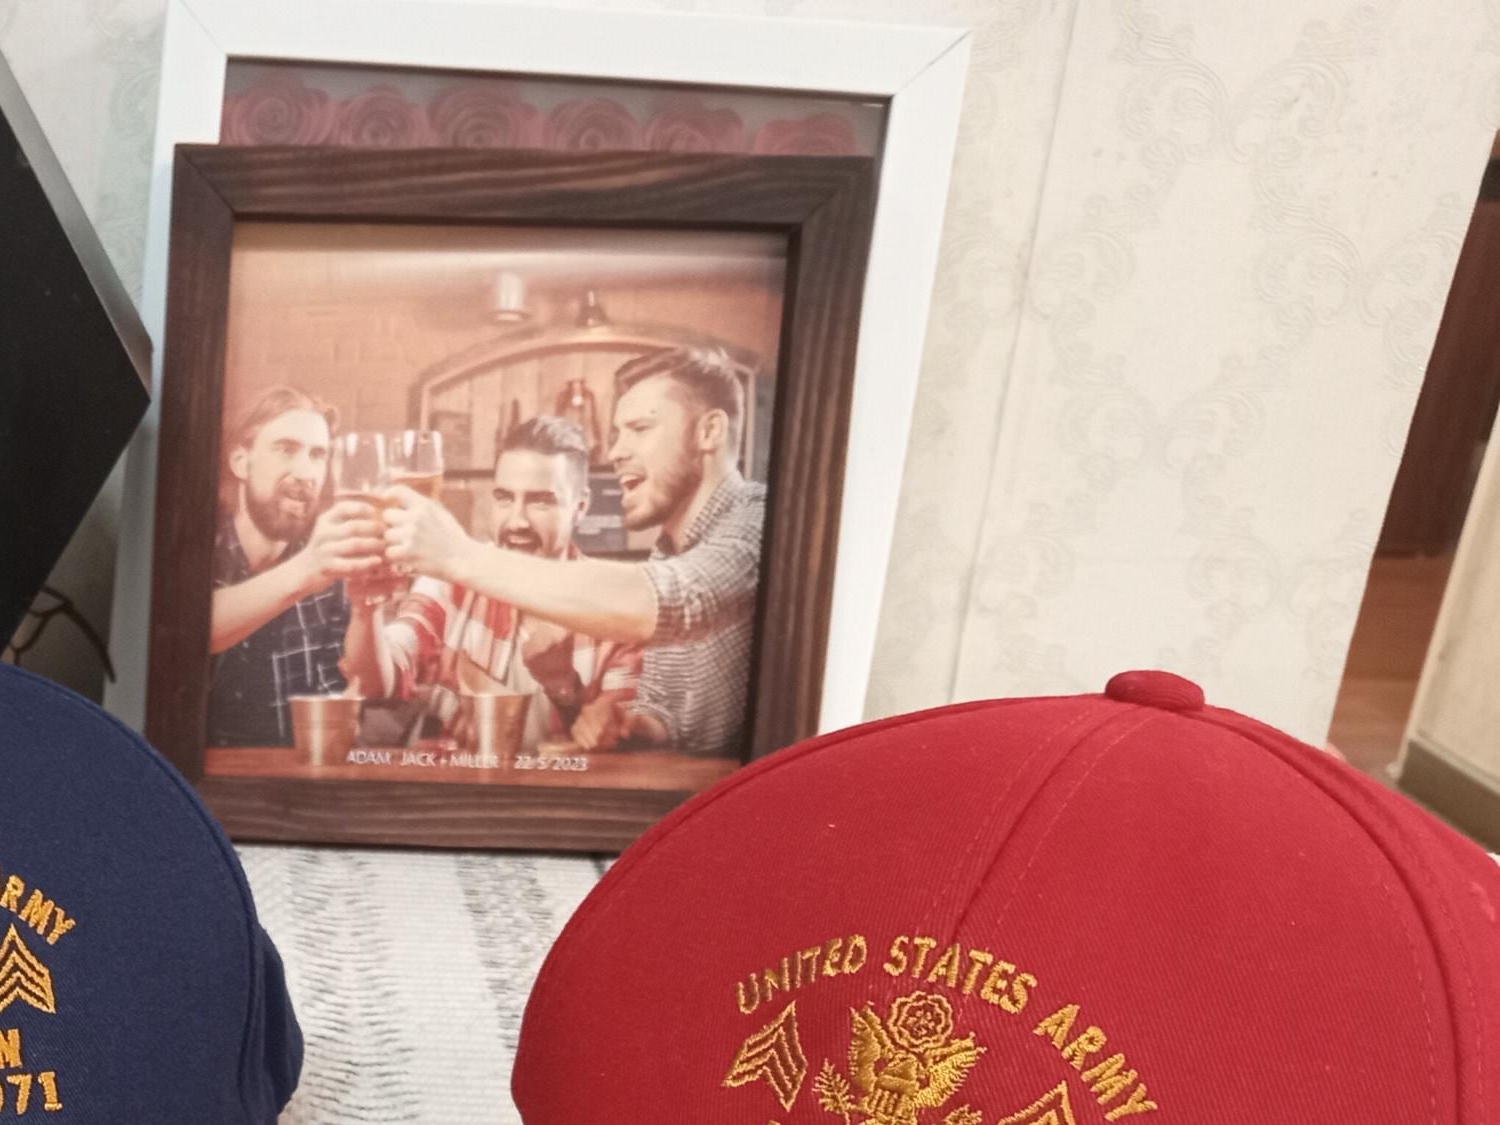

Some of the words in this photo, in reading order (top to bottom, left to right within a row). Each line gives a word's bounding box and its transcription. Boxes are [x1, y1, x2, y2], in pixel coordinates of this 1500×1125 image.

[399, 752, 437, 769] JACK
[736, 934, 866, 1014] UNITED
[884, 935, 1038, 1014] STATES
[1033, 1003, 1158, 1122] ARMY
